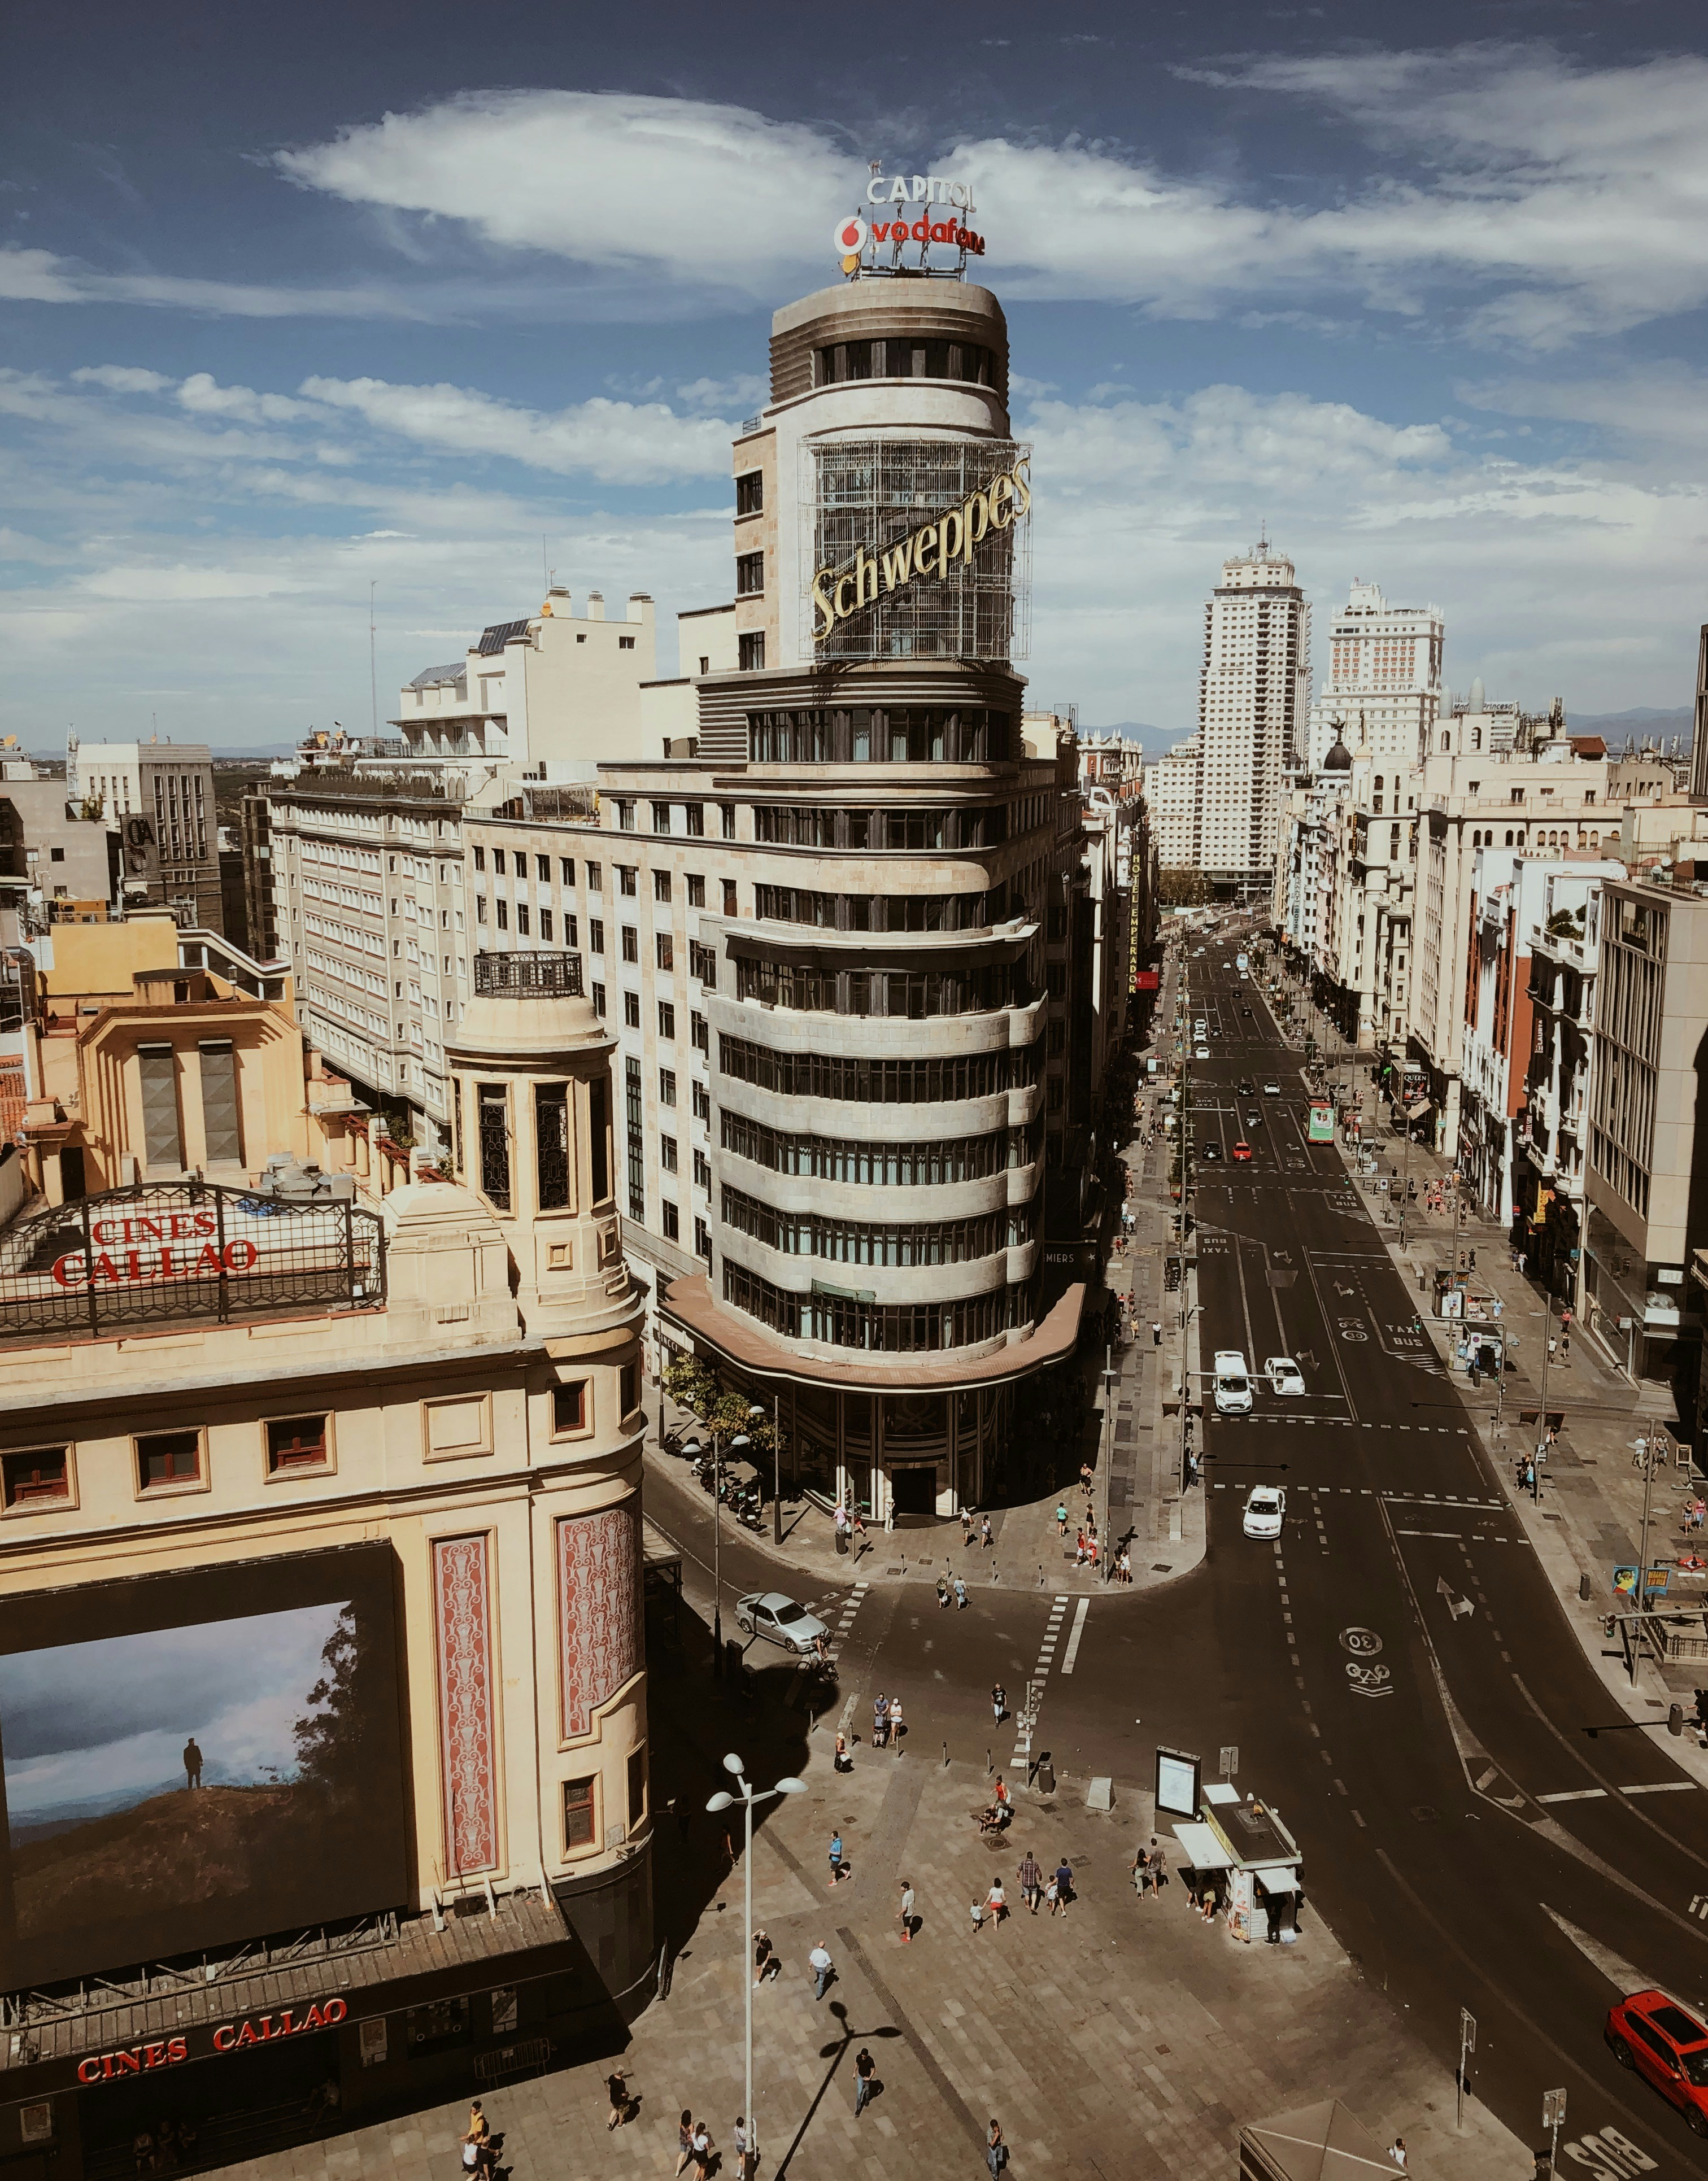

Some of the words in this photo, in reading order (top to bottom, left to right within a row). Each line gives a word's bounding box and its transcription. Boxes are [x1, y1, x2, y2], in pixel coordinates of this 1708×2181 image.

[866, 175, 977, 213] CAPITOL
[872, 215, 985, 255] vodafone
[812, 458, 1031, 641] Schweppes
[1129, 909, 1138, 993] EMPERADOR
[93, 1211, 215, 1246] CINES
[53, 1239, 258, 1287] CALLAO
[1385, 1325, 1420, 1334] TAXI
[1393, 1337, 1423, 1347] BUS
[77, 2036, 188, 2084] CINES
[212, 1997, 348, 2053] CALLAO
[1563, 2125, 1660, 2181] BUS
